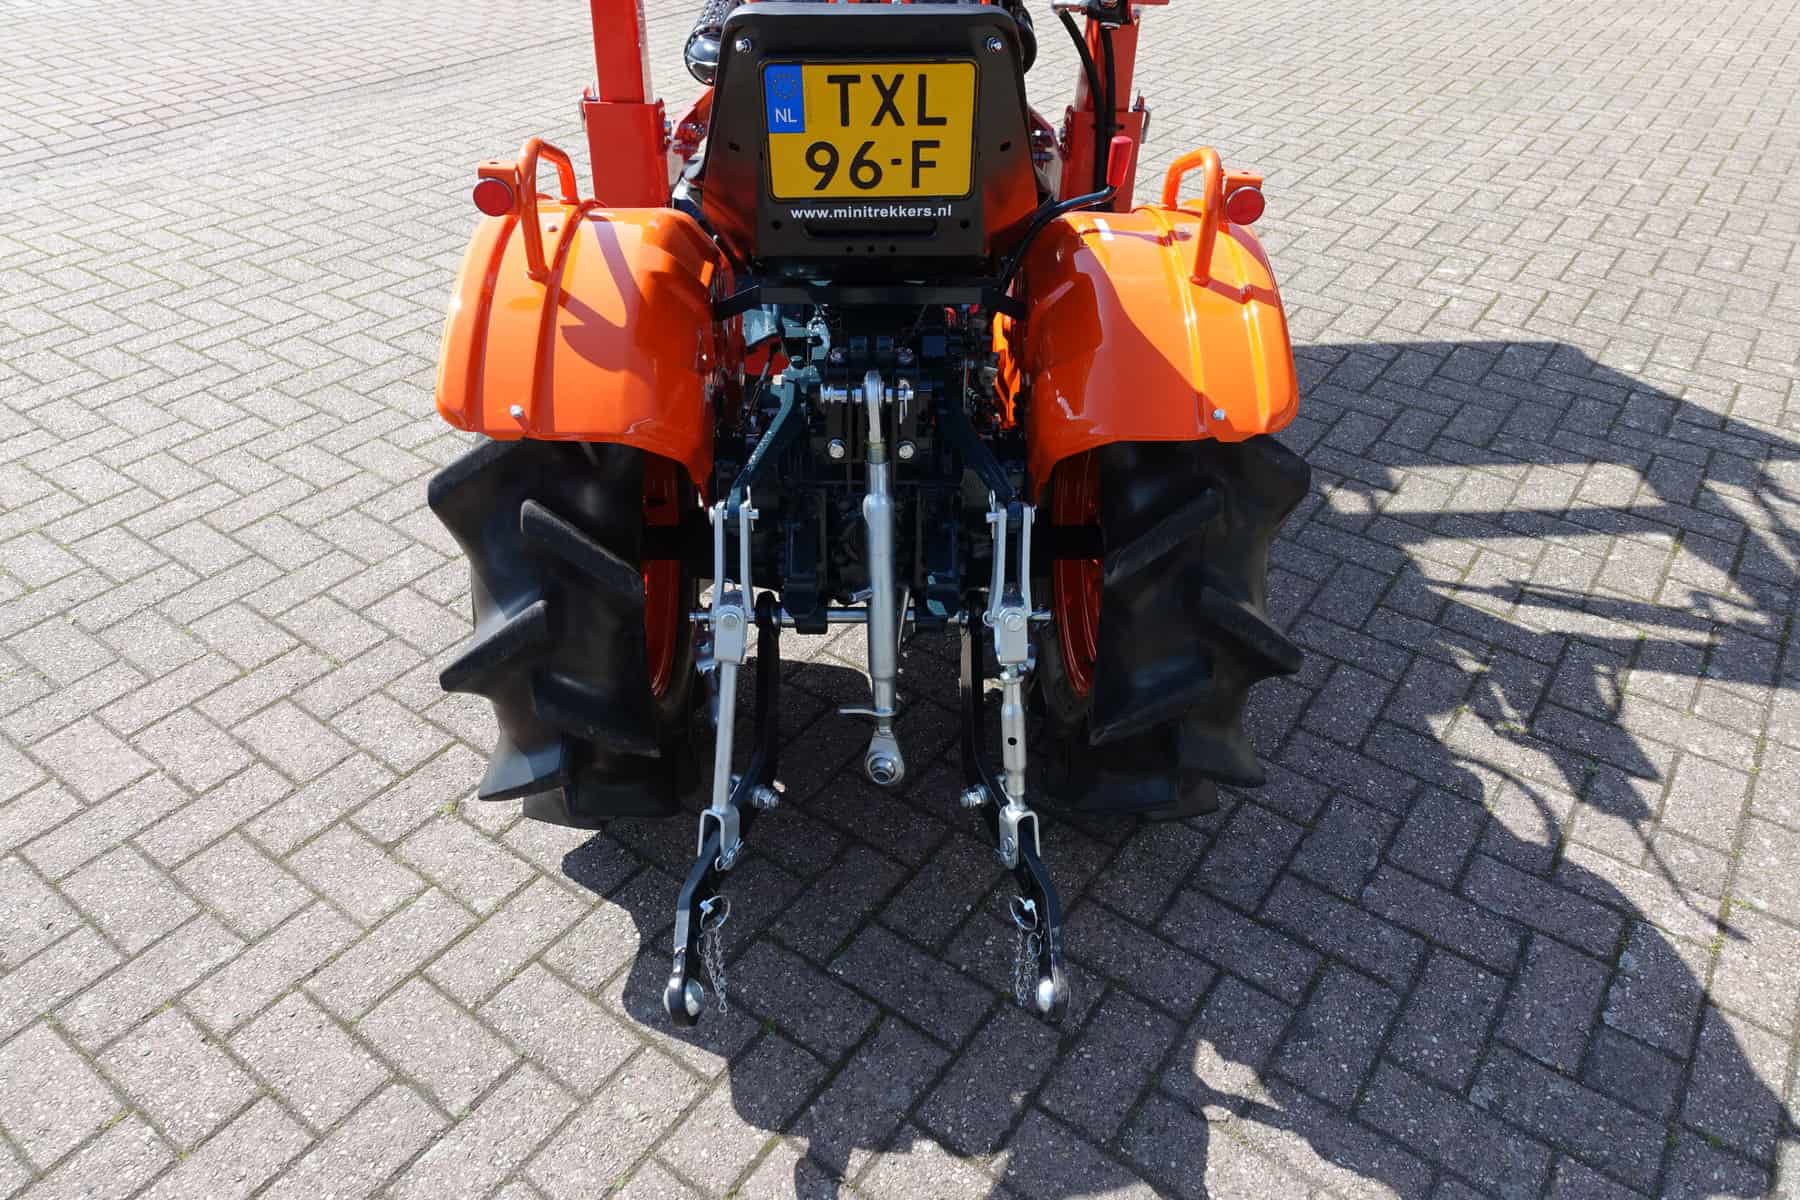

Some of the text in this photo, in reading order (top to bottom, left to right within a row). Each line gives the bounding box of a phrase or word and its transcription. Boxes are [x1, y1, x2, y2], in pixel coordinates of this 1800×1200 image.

[775, 107, 798, 123] NL
[826, 73, 948, 127] TXL
[805, 140, 941, 191] 96-F
[790, 204, 952, 219] www.minitrekkers.nl
